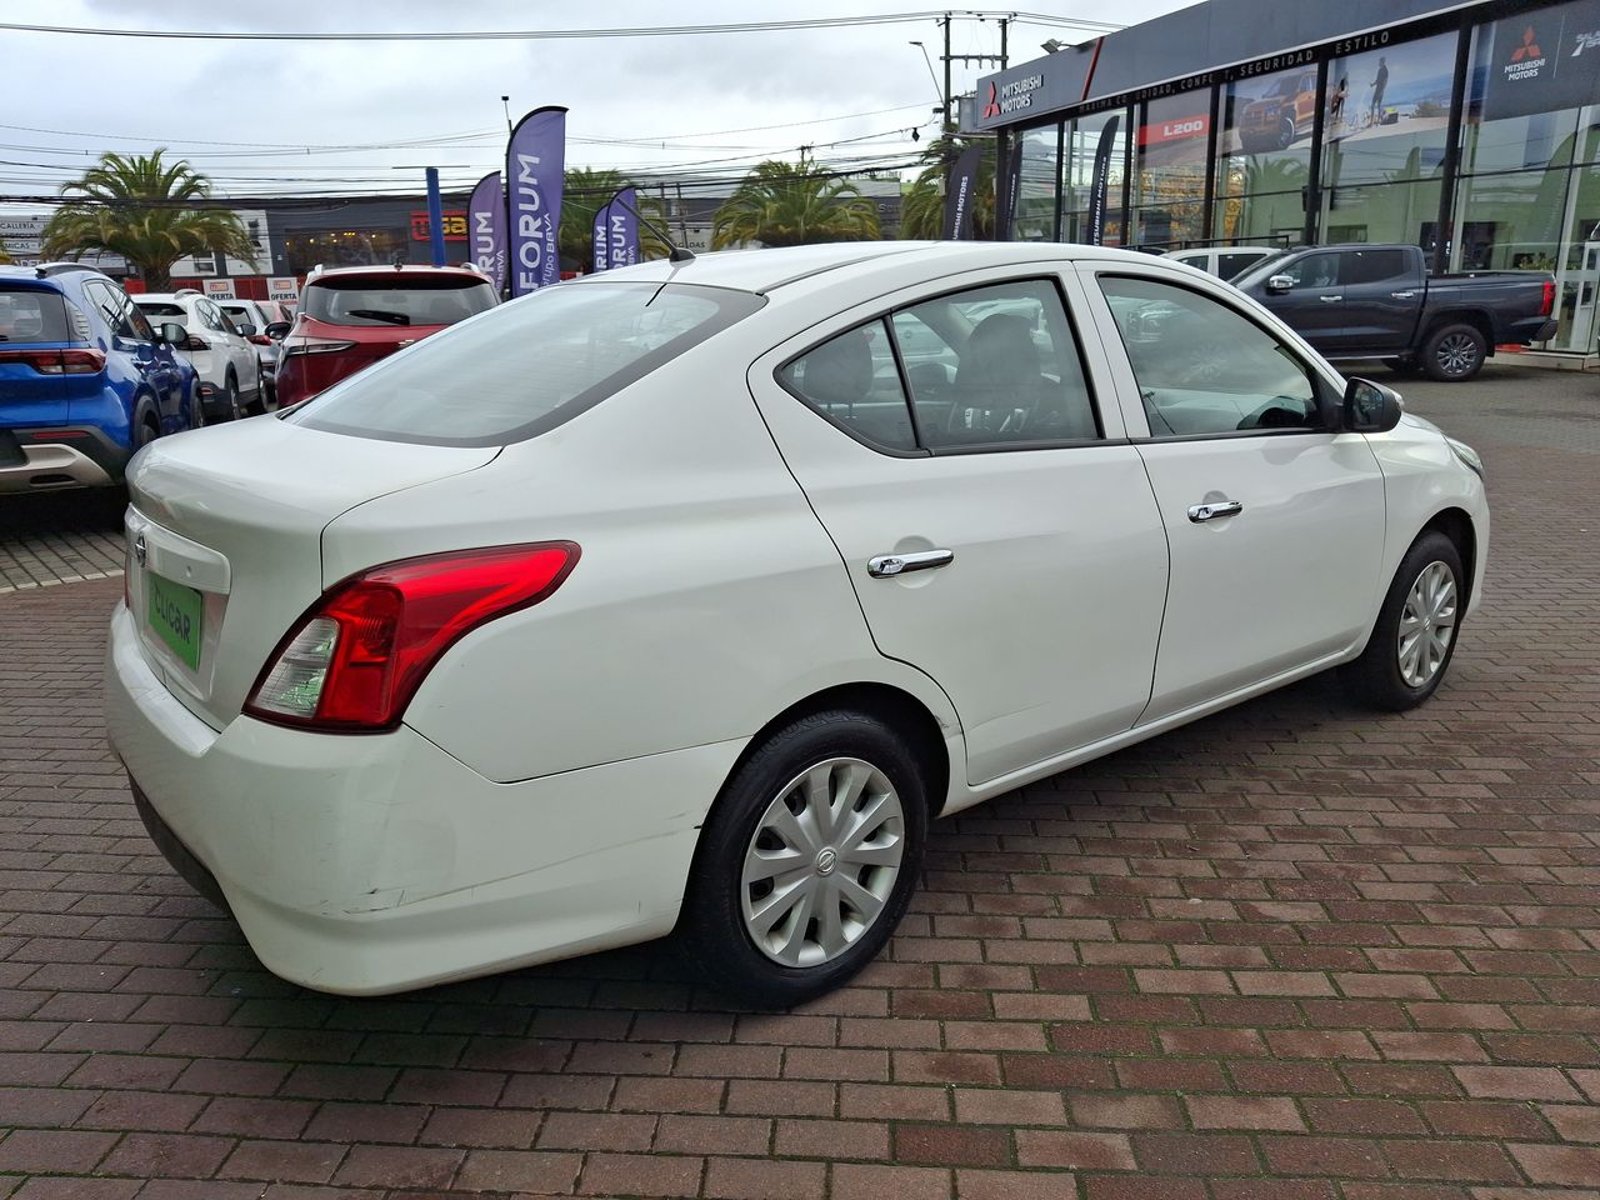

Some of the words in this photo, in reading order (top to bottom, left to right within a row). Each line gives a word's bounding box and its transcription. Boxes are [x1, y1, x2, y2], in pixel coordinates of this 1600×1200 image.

[1240, 50, 1314, 77] SEGURIDAD
[1335, 30, 1390, 55] ESTILO
[1504, 58, 1546, 74] MITSUBISHI
[1508, 68, 1539, 81] MOTORS
[1001, 74, 1044, 99] MITSUBISHI
[1001, 93, 1032, 114] MOTORS
[1163, 120, 1203, 137] L200
[956, 175, 969, 212] MOTORS
[517, 153, 543, 290] FORUM
